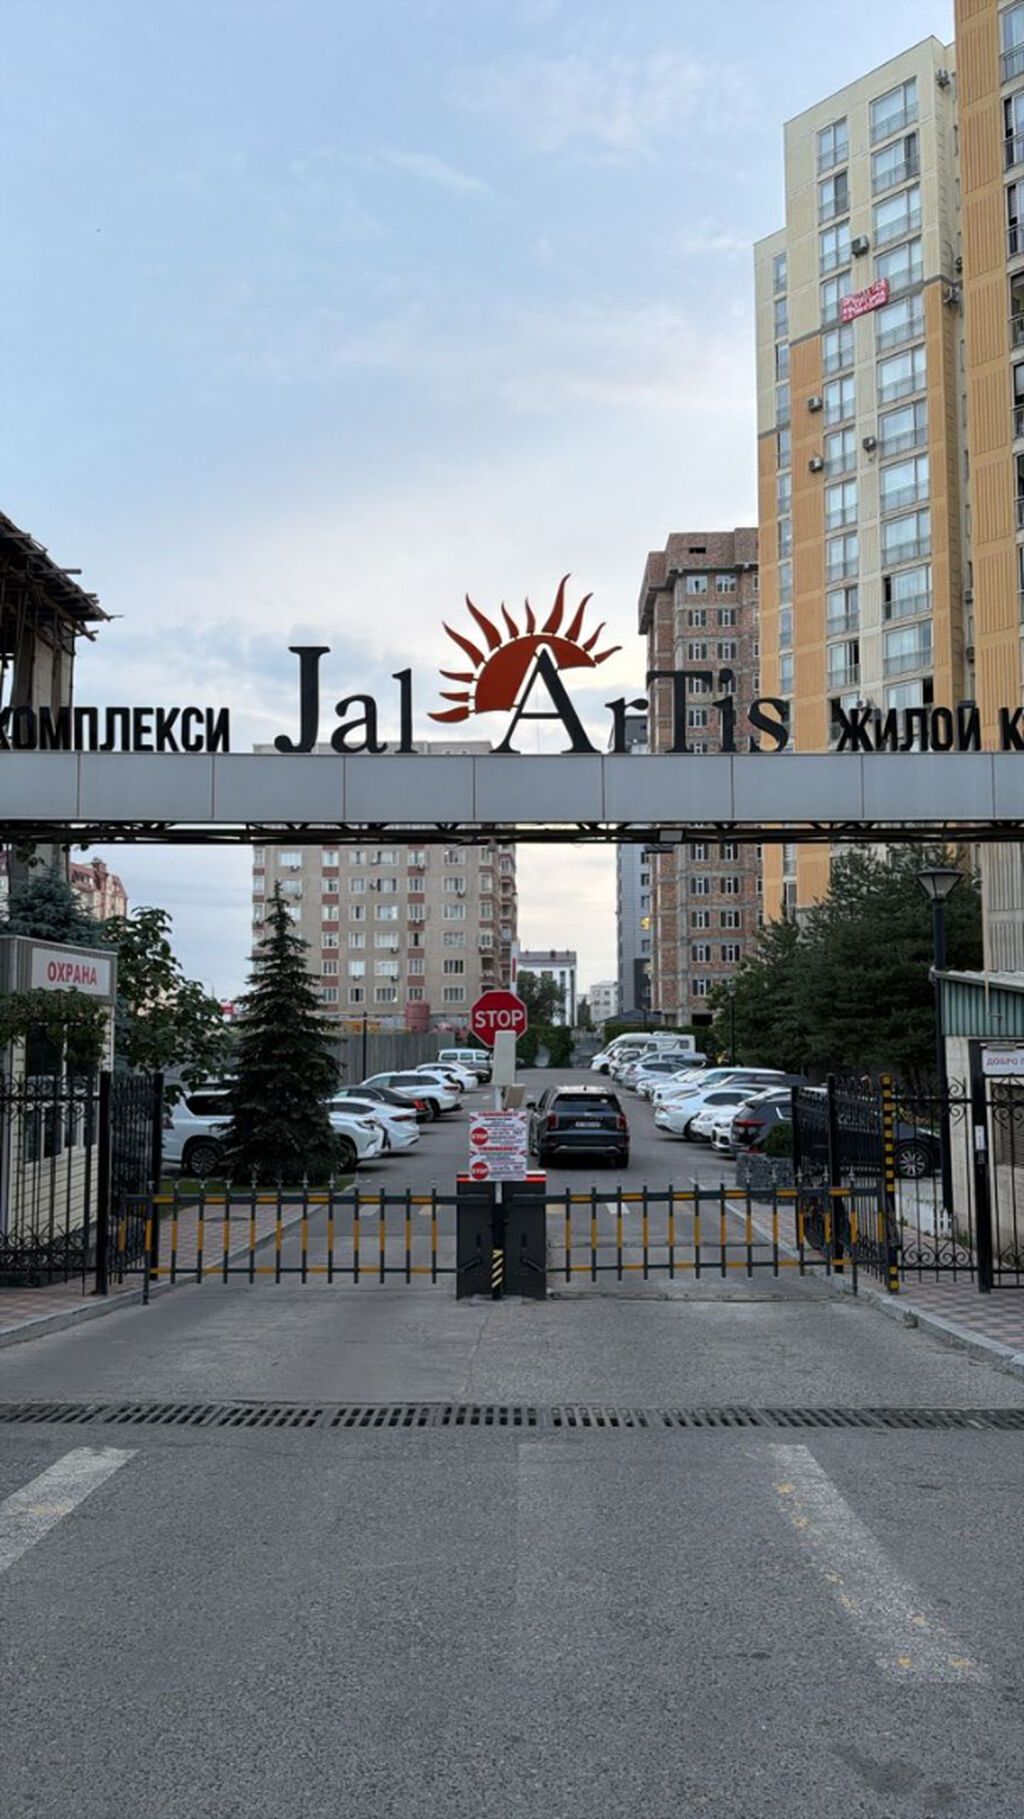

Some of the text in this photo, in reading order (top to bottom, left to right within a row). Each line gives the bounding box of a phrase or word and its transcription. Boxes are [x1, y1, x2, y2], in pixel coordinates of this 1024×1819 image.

[274, 646, 418, 753] Jal
[836, 700, 982, 752] ЖИЛОЙ
[47, 961, 97, 985] ОХРАНА
[475, 1010, 523, 1028] STOP
